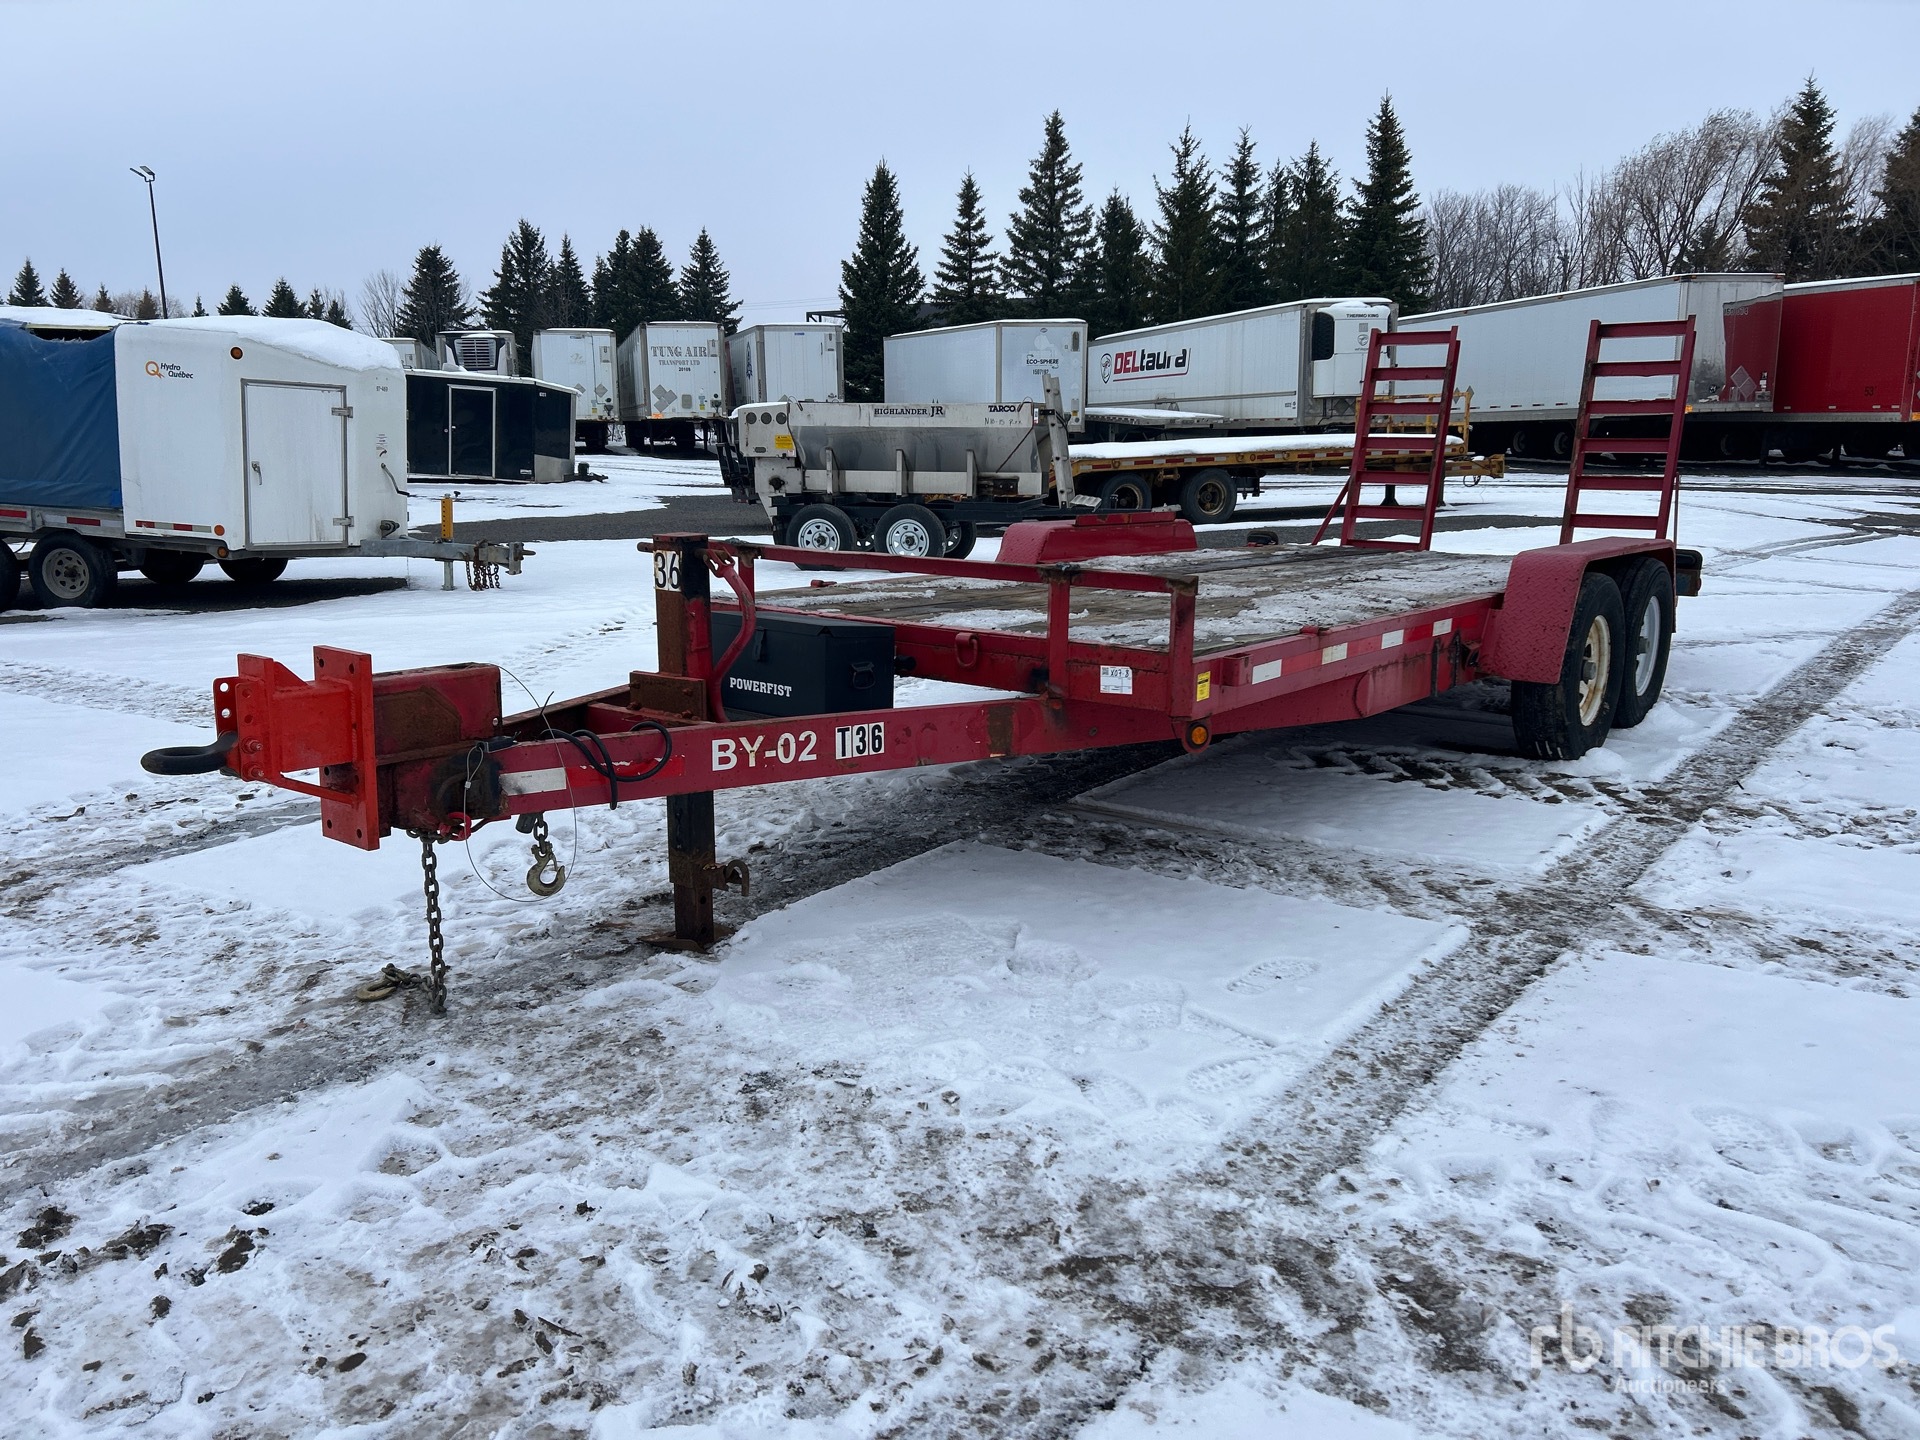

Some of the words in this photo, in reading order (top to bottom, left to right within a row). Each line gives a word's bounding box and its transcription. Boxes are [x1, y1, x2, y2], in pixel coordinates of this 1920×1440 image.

[651, 346, 682, 358] TUNG
[685, 346, 707, 357] AIR
[160, 362, 181, 371] Hydro
[168, 370, 194, 379] Québec
[930, 405, 944, 418] JR
[988, 405, 1016, 413] TARCO
[654, 552, 681, 589] 36
[729, 677, 792, 697] POWERFIST
[711, 730, 818, 772] BY-02
[836, 723, 884, 758] T36
